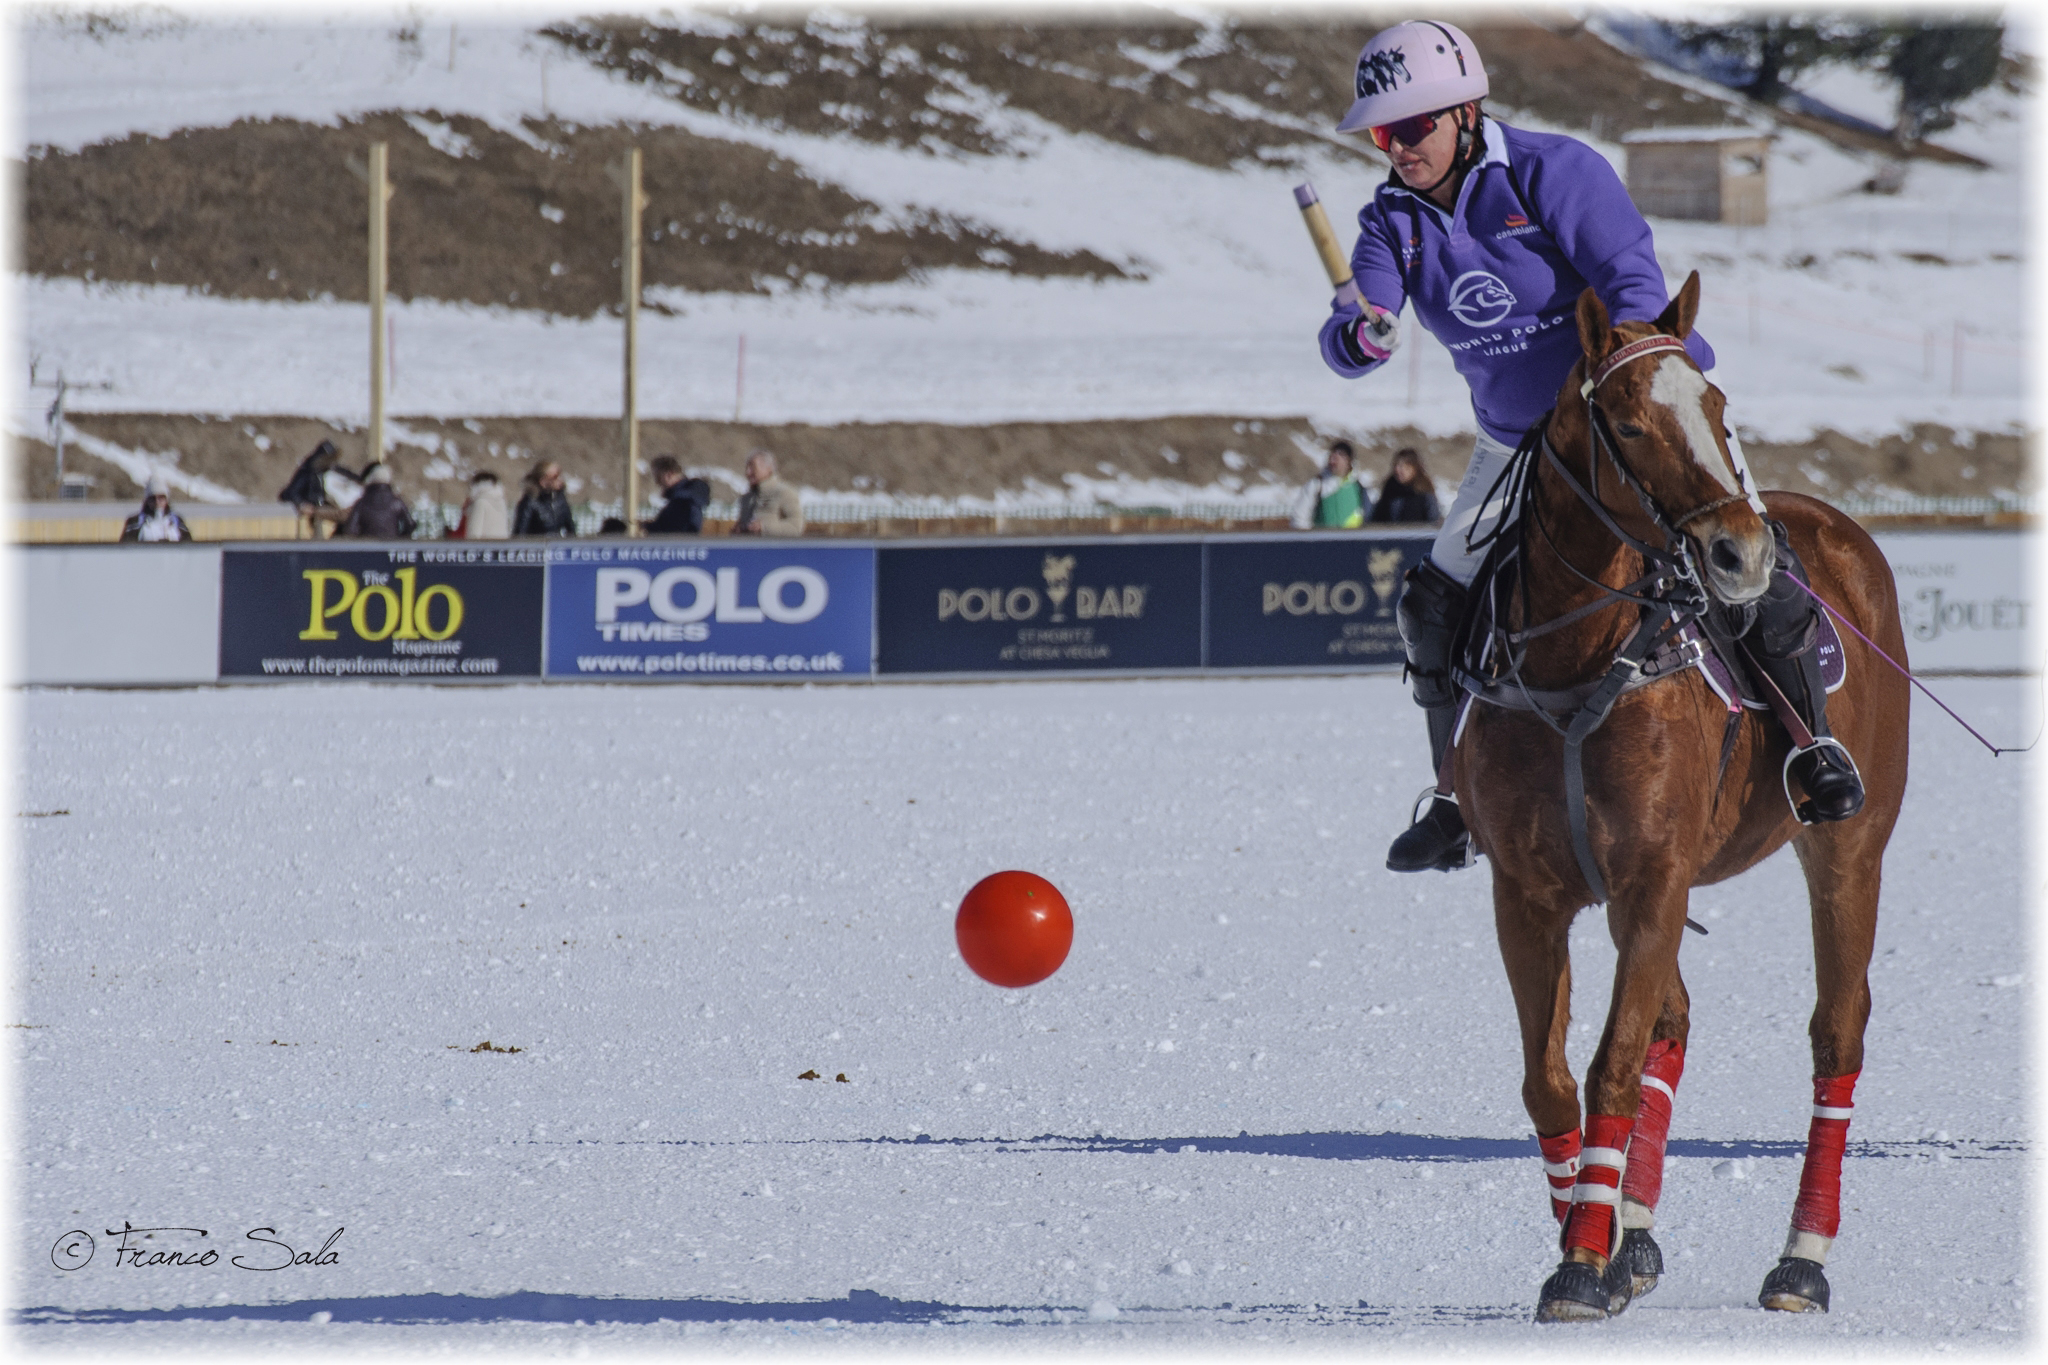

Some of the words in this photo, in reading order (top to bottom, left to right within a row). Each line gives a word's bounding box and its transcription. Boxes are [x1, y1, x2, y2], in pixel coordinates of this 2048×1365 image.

[1495, 225, 1542, 240] casablanc
[1449, 332, 1503, 351] WORLD
[1511, 316, 1564, 338] POLO
[1483, 342, 1529, 357] LEAGUE
[387, 551, 415, 563] THE
[422, 550, 492, 563] WORLD'S
[498, 548, 564, 562] LEADING
[571, 548, 611, 561] POLO
[618, 546, 709, 561] MAGAZINES
[362, 570, 389, 586] The
[299, 566, 464, 641] Polo
[595, 566, 829, 624] POLO
[938, 587, 1041, 622] POLO
[1076, 585, 1148, 619] BAR
[1262, 580, 1366, 616] POLO
[595, 622, 710, 642] TIMES
[392, 638, 462, 656] Magazine
[1819, 644, 1836, 656] POLO
[261, 656, 499, 676] www.thepolomagazine.com
[576, 651, 844, 674] www.polotimes.co.uk
